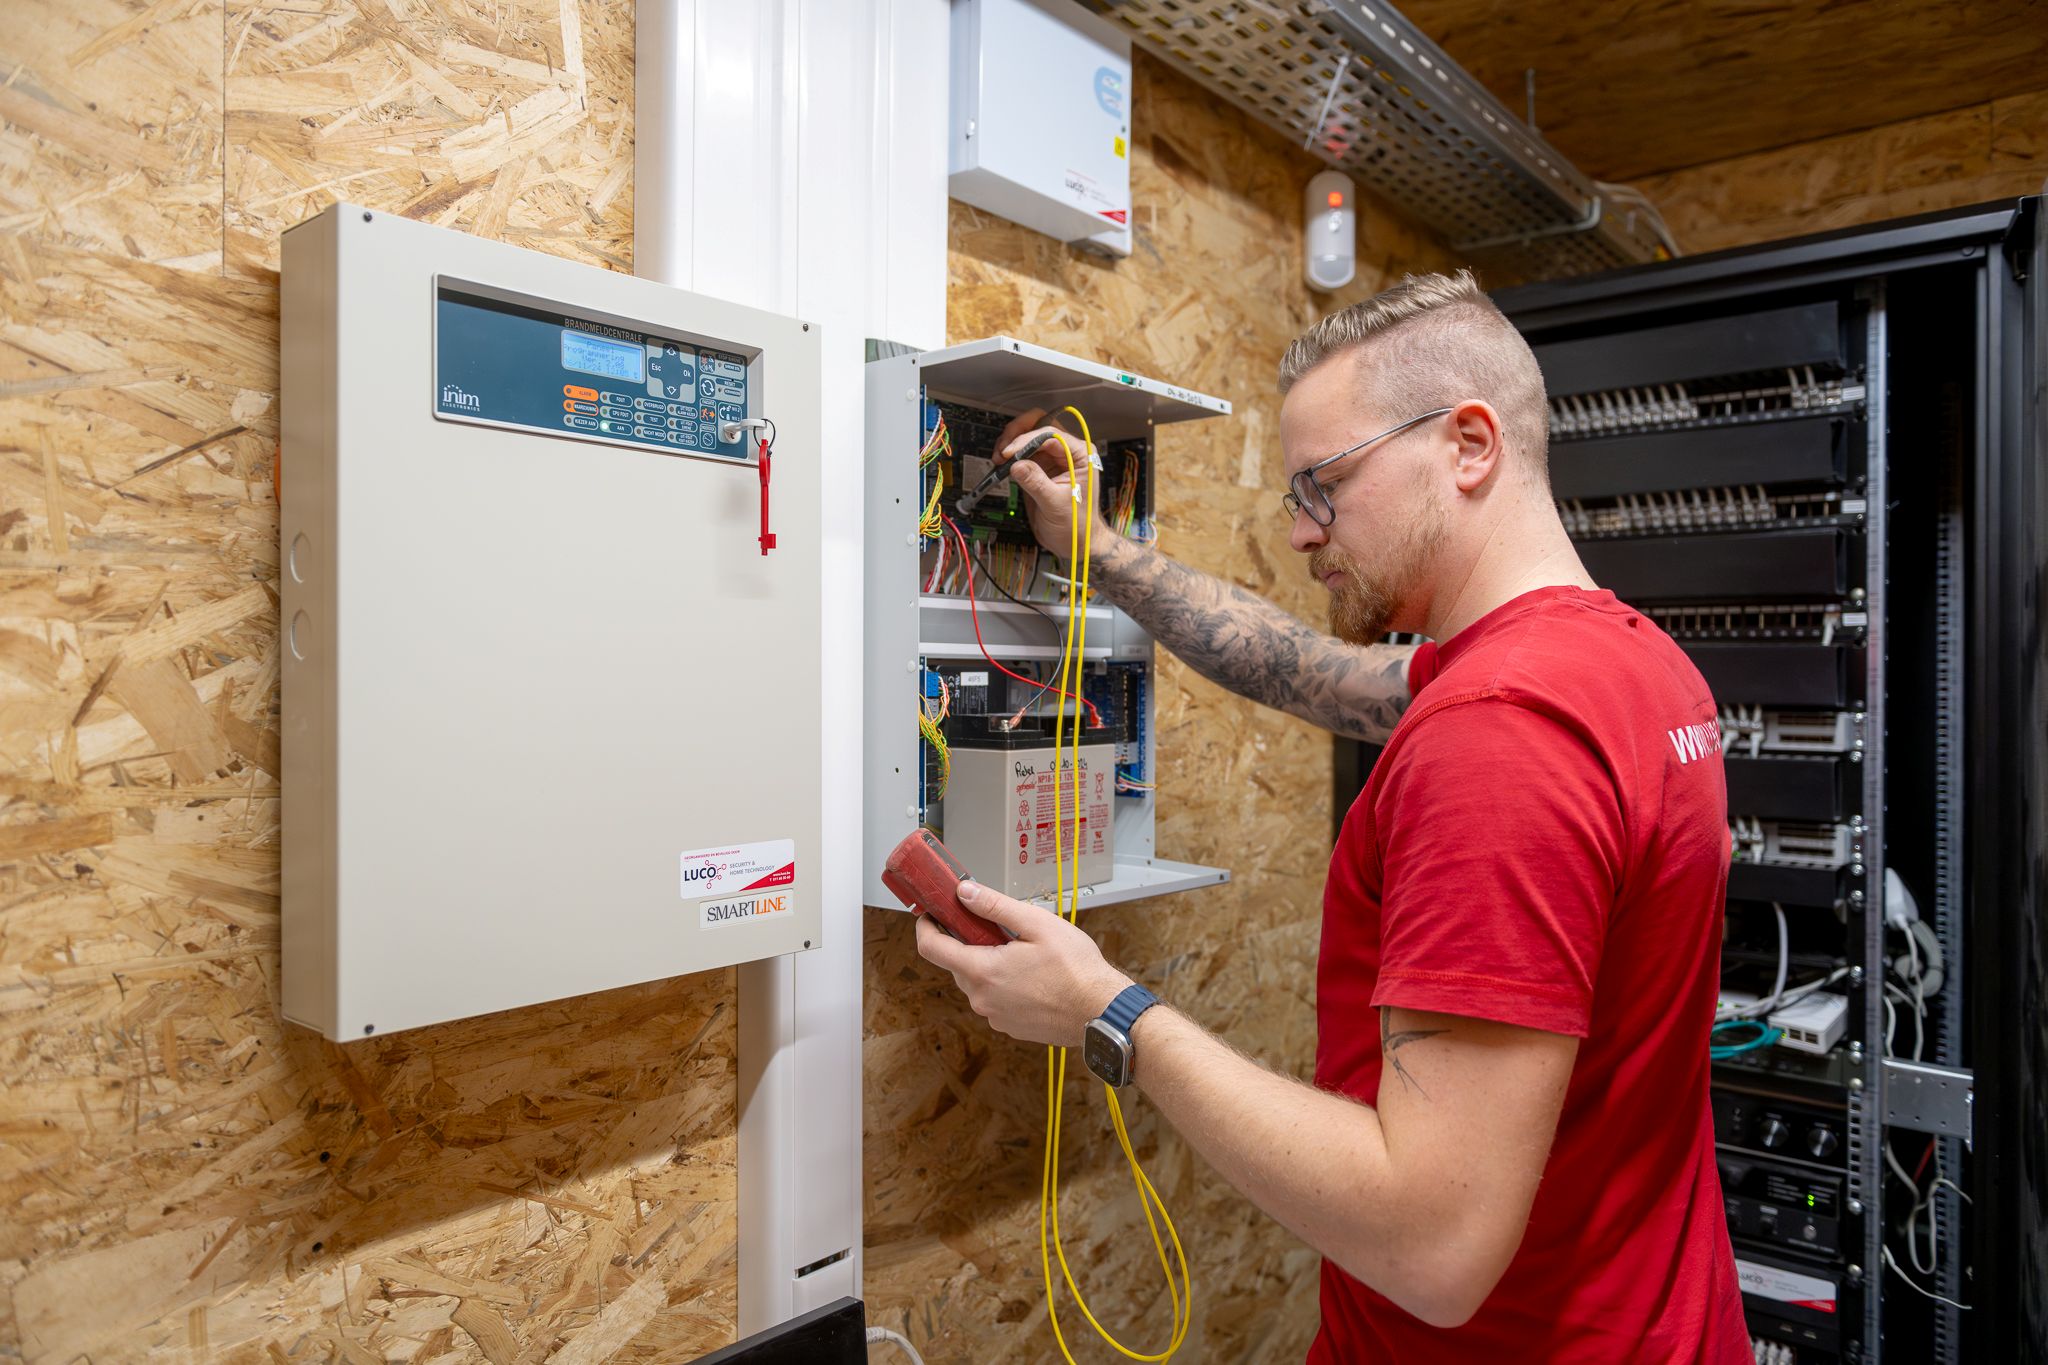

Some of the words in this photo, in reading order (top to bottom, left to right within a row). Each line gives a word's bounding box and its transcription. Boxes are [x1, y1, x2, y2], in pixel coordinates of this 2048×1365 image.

[564, 318, 643, 343] BRANDMELDCENTRALE
[651, 362, 662, 373] Esc
[683, 369, 692, 378] Ok
[443, 385, 480, 407] inim
[442, 402, 481, 412] ELECTRONICS
[729, 861, 751, 869] SECURITY
[729, 868, 744, 876] HOME
[744, 865, 776, 875] TECHNOLOGY
[684, 866, 716, 882] LUCO
[707, 895, 787, 922] SMARTLINE
